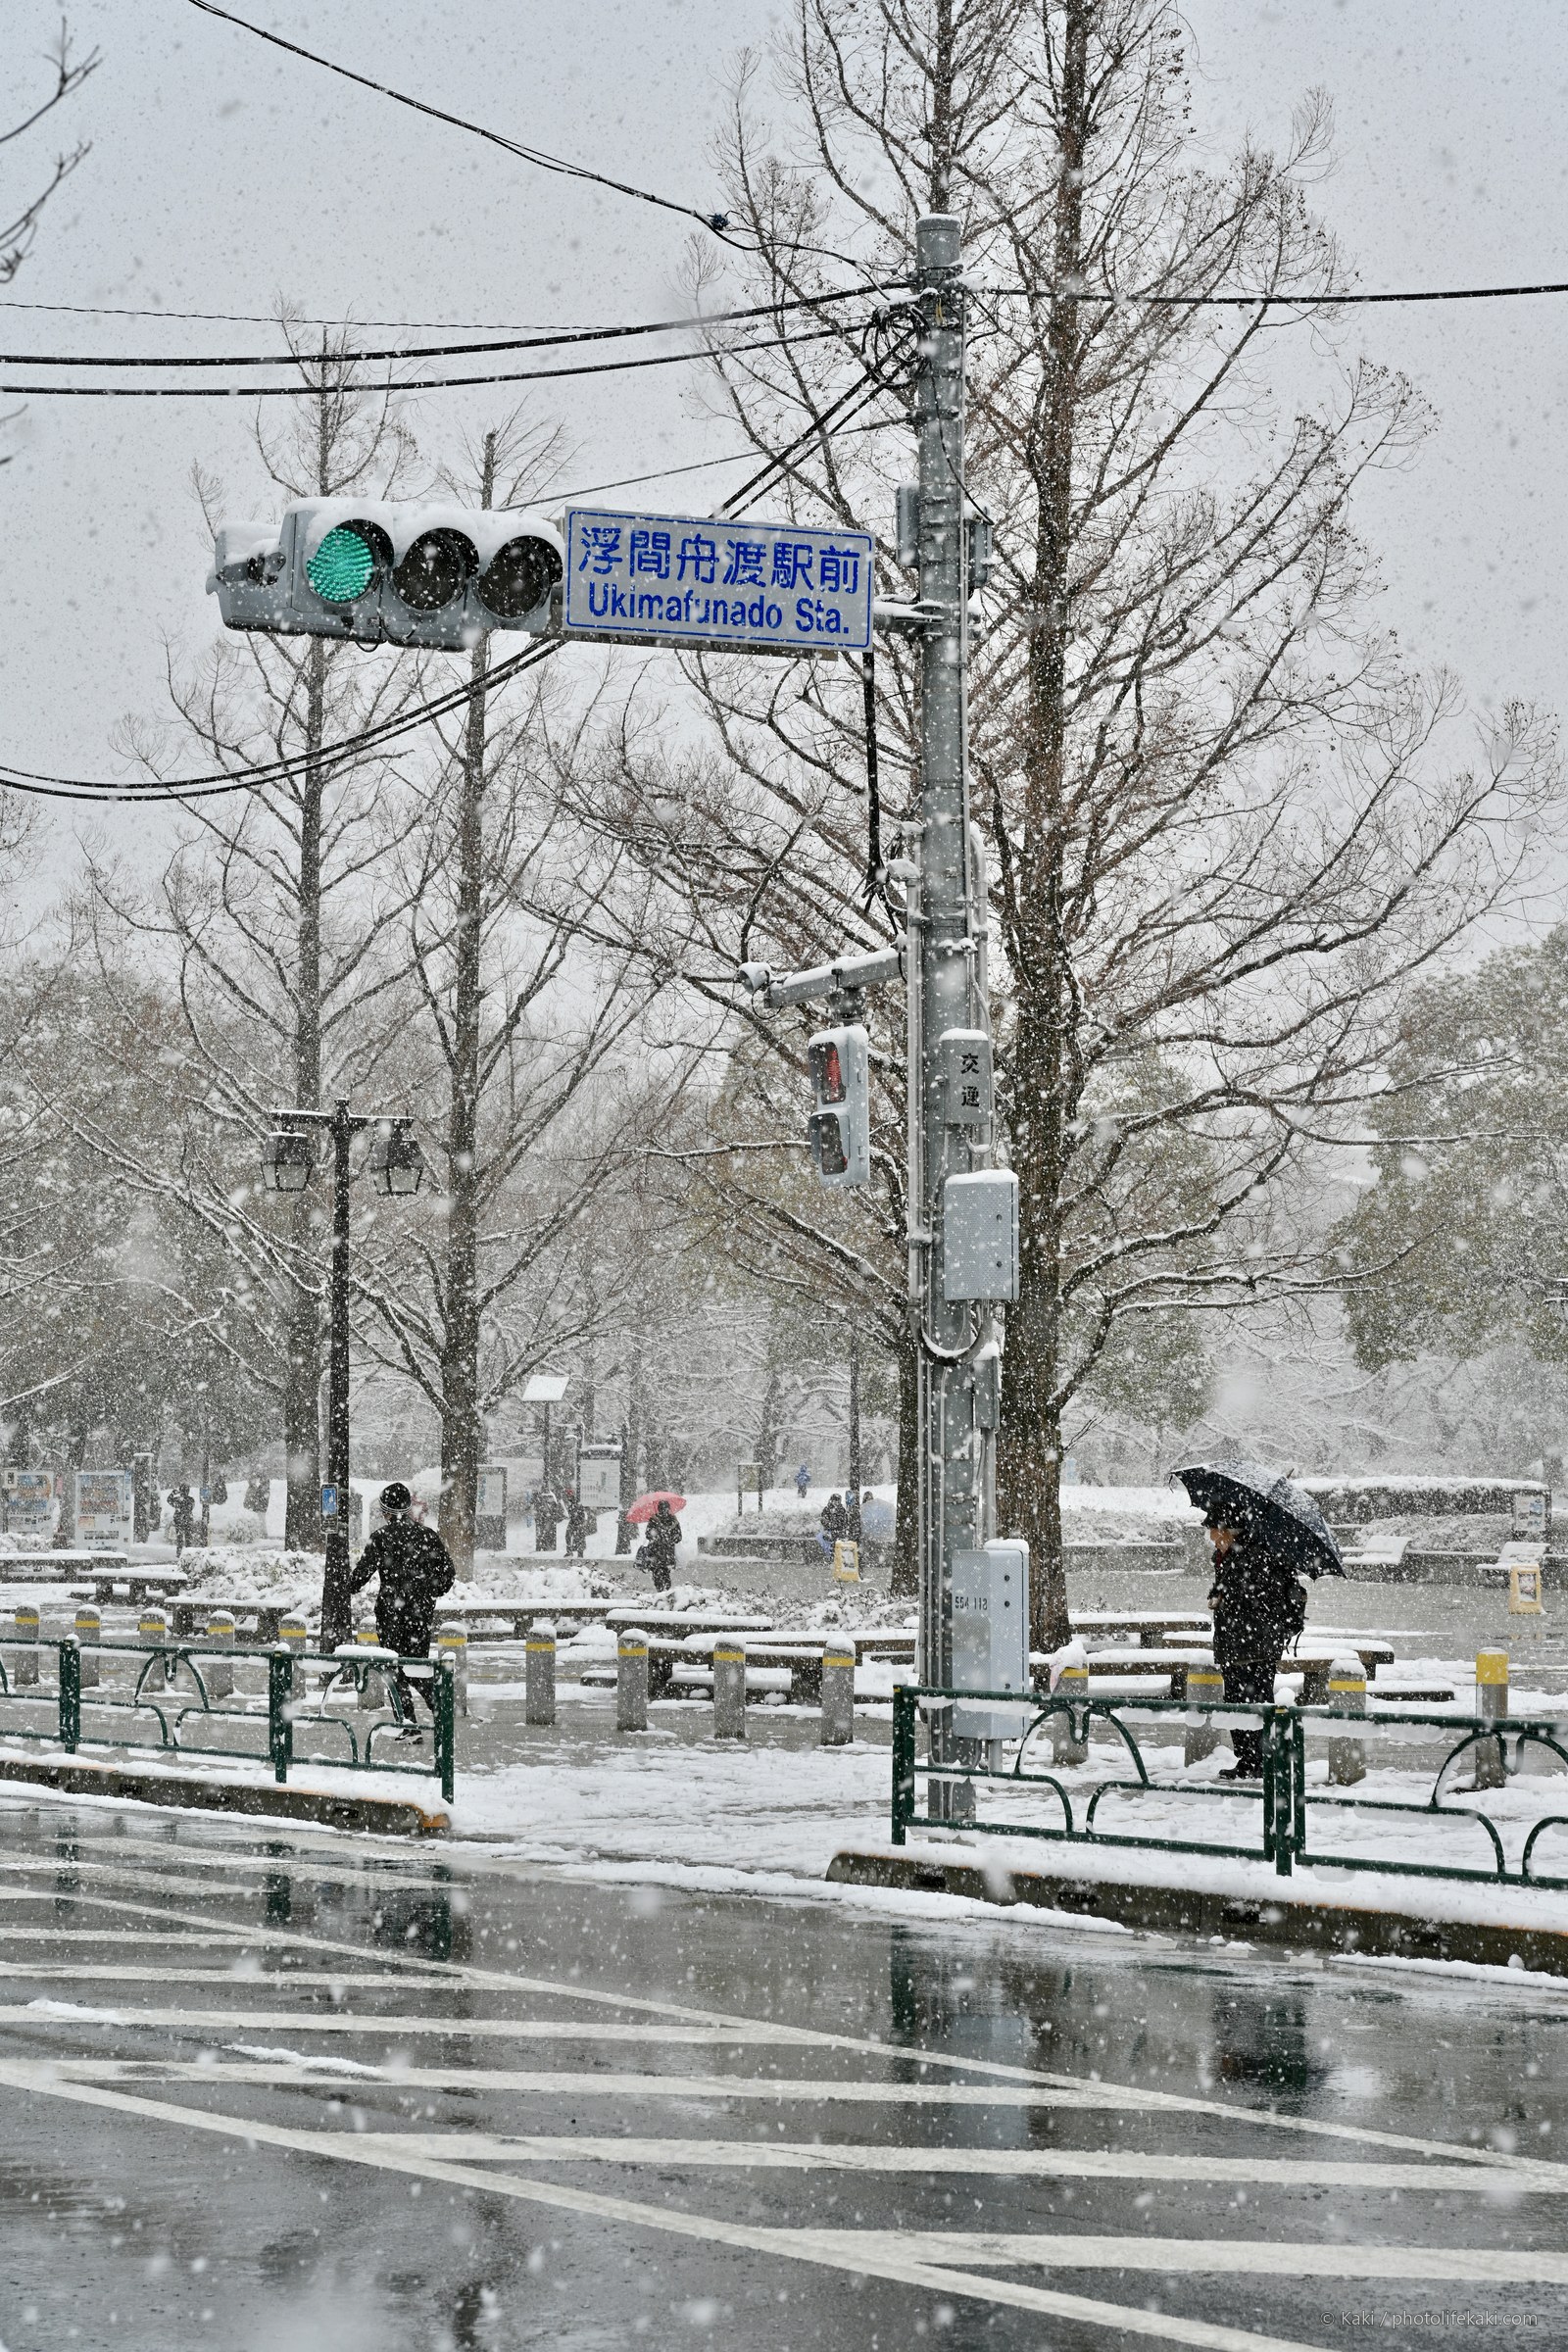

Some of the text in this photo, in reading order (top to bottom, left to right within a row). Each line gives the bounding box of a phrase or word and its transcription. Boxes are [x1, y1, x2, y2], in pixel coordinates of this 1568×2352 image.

[578, 526, 860, 594] 浮間舟渡駅前
[589, 581, 850, 634] Ukimafunado Sta.
[960, 1053, 981, 1107] 交通
